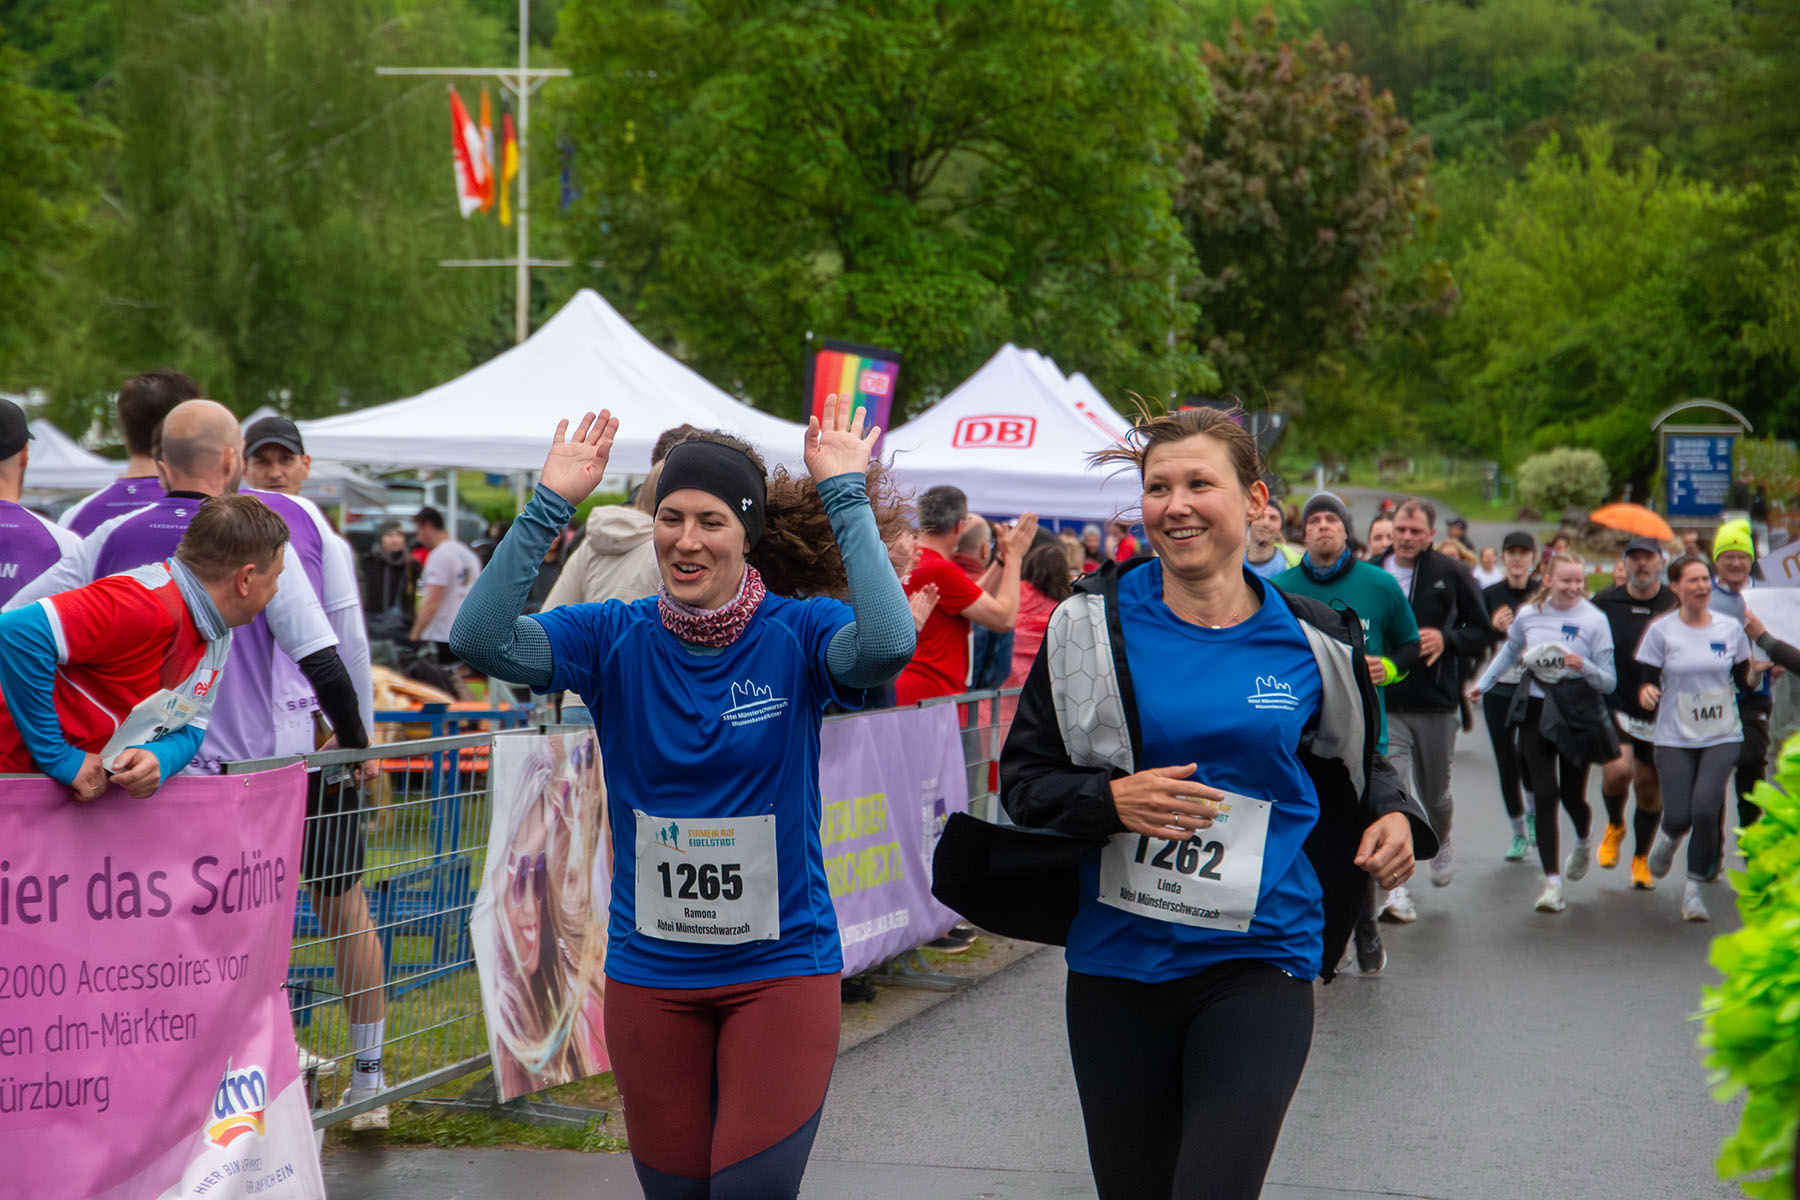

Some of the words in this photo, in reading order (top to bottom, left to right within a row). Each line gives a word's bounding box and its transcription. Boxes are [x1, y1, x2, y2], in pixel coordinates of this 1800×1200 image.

[963, 421, 1025, 443] DB
[722, 713, 738, 722] Abtei
[738, 701, 788, 719] Münsterschwarzach
[1692, 705, 1723, 721] 1447
[688, 829, 736, 838] FIRMENLAUF
[688, 838, 736, 848] EIBELSTADT
[1134, 834, 1225, 881] 1262
[86, 856, 173, 921] das
[190, 850, 286, 916] Schöne
[657, 861, 743, 901] 1265
[1157, 878, 1182, 894] Linda
[684, 907, 717, 919] Ramona
[1119, 887, 1137, 901] Abtei
[1137, 892, 1221, 920] Münsterschwarzach
[657, 919, 675, 932] Abtei
[675, 922, 751, 937] Münsterschwarzach
[0, 963, 66, 999] 2000
[77, 953, 212, 994] Accessoires
[217, 953, 249, 982] von
[45, 1008, 197, 1052] dm-Märkten
[214, 1056, 265, 1120] dm
[193, 1170, 225, 1194] HIER
[222, 1159, 241, 1176] BIN
[276, 1163, 294, 1183] EIN
